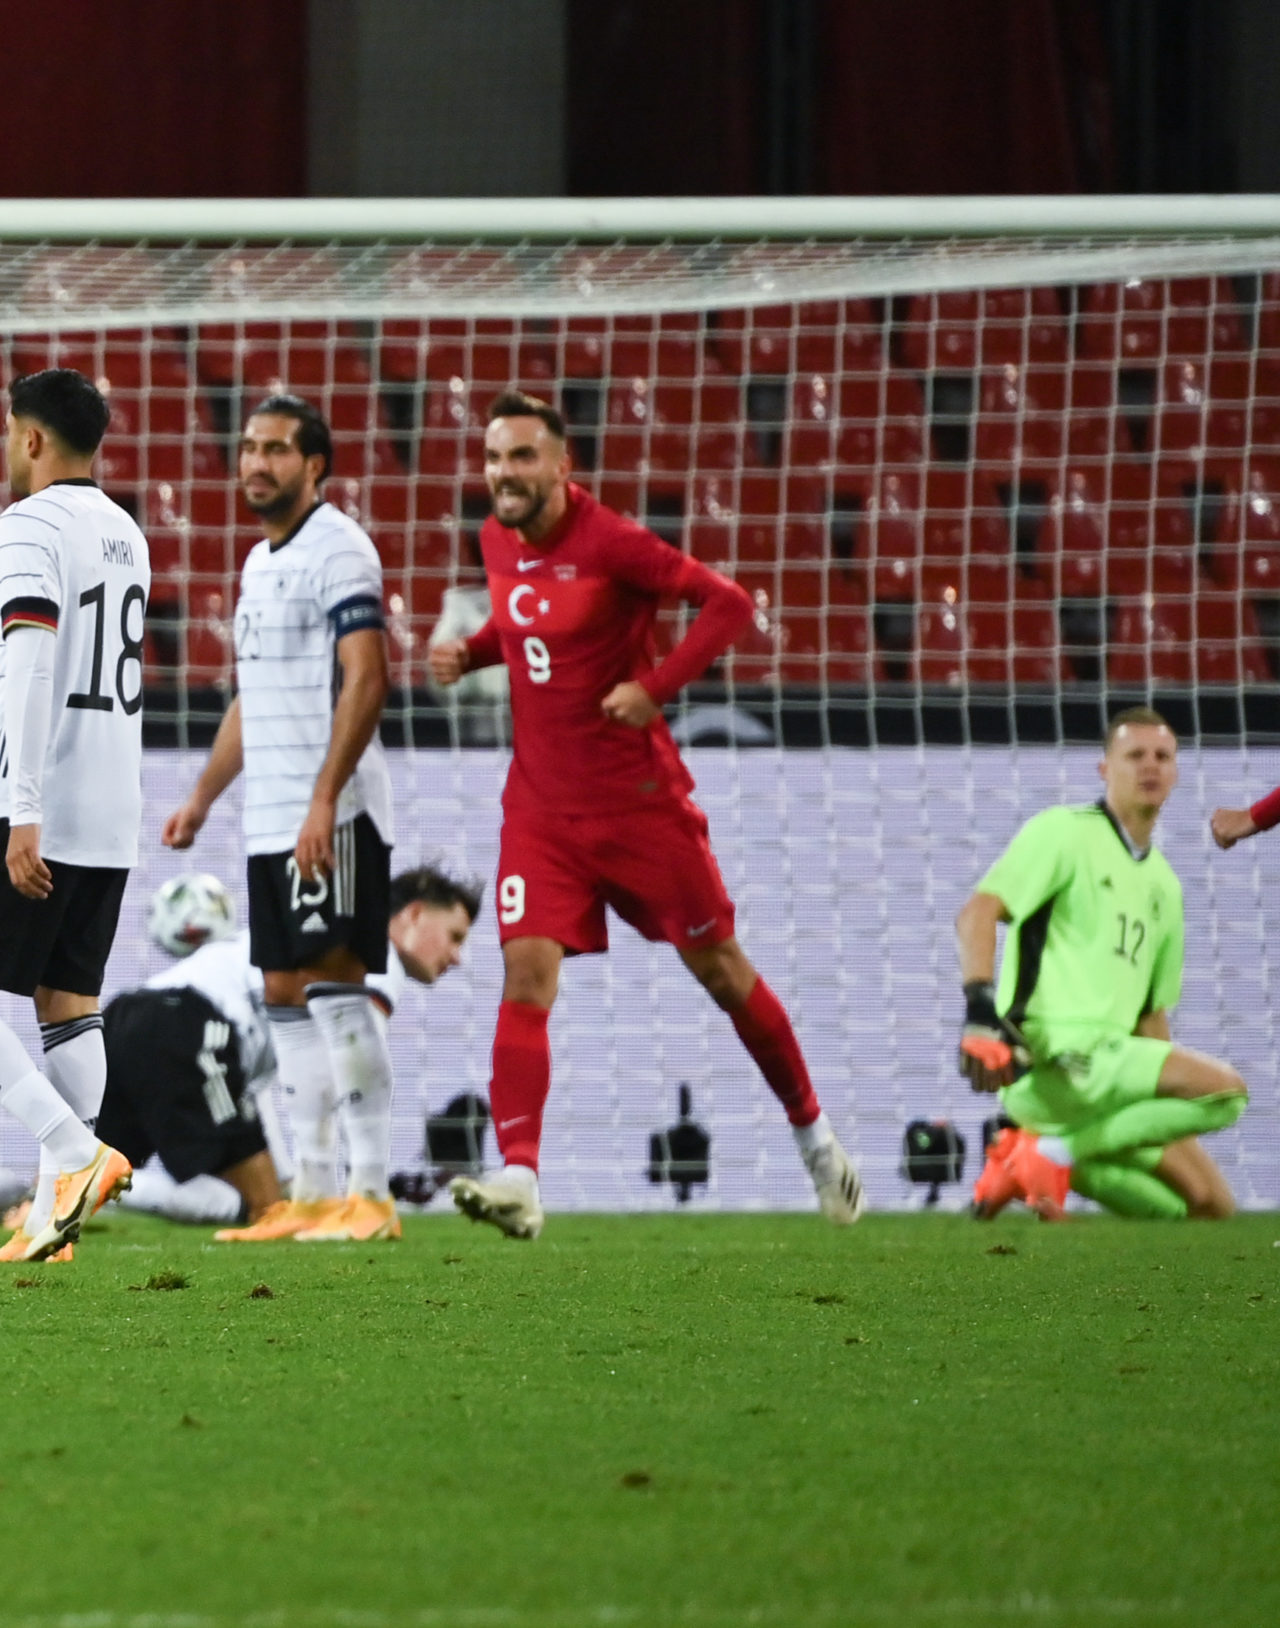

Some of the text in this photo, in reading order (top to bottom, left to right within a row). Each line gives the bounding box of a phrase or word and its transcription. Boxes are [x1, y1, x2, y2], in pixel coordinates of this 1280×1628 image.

[101, 537, 134, 567] AMIRI
[66, 581, 146, 716] 18
[524, 636, 552, 683] 9
[500, 874, 526, 924] 9
[1113, 912, 1146, 967] 12
